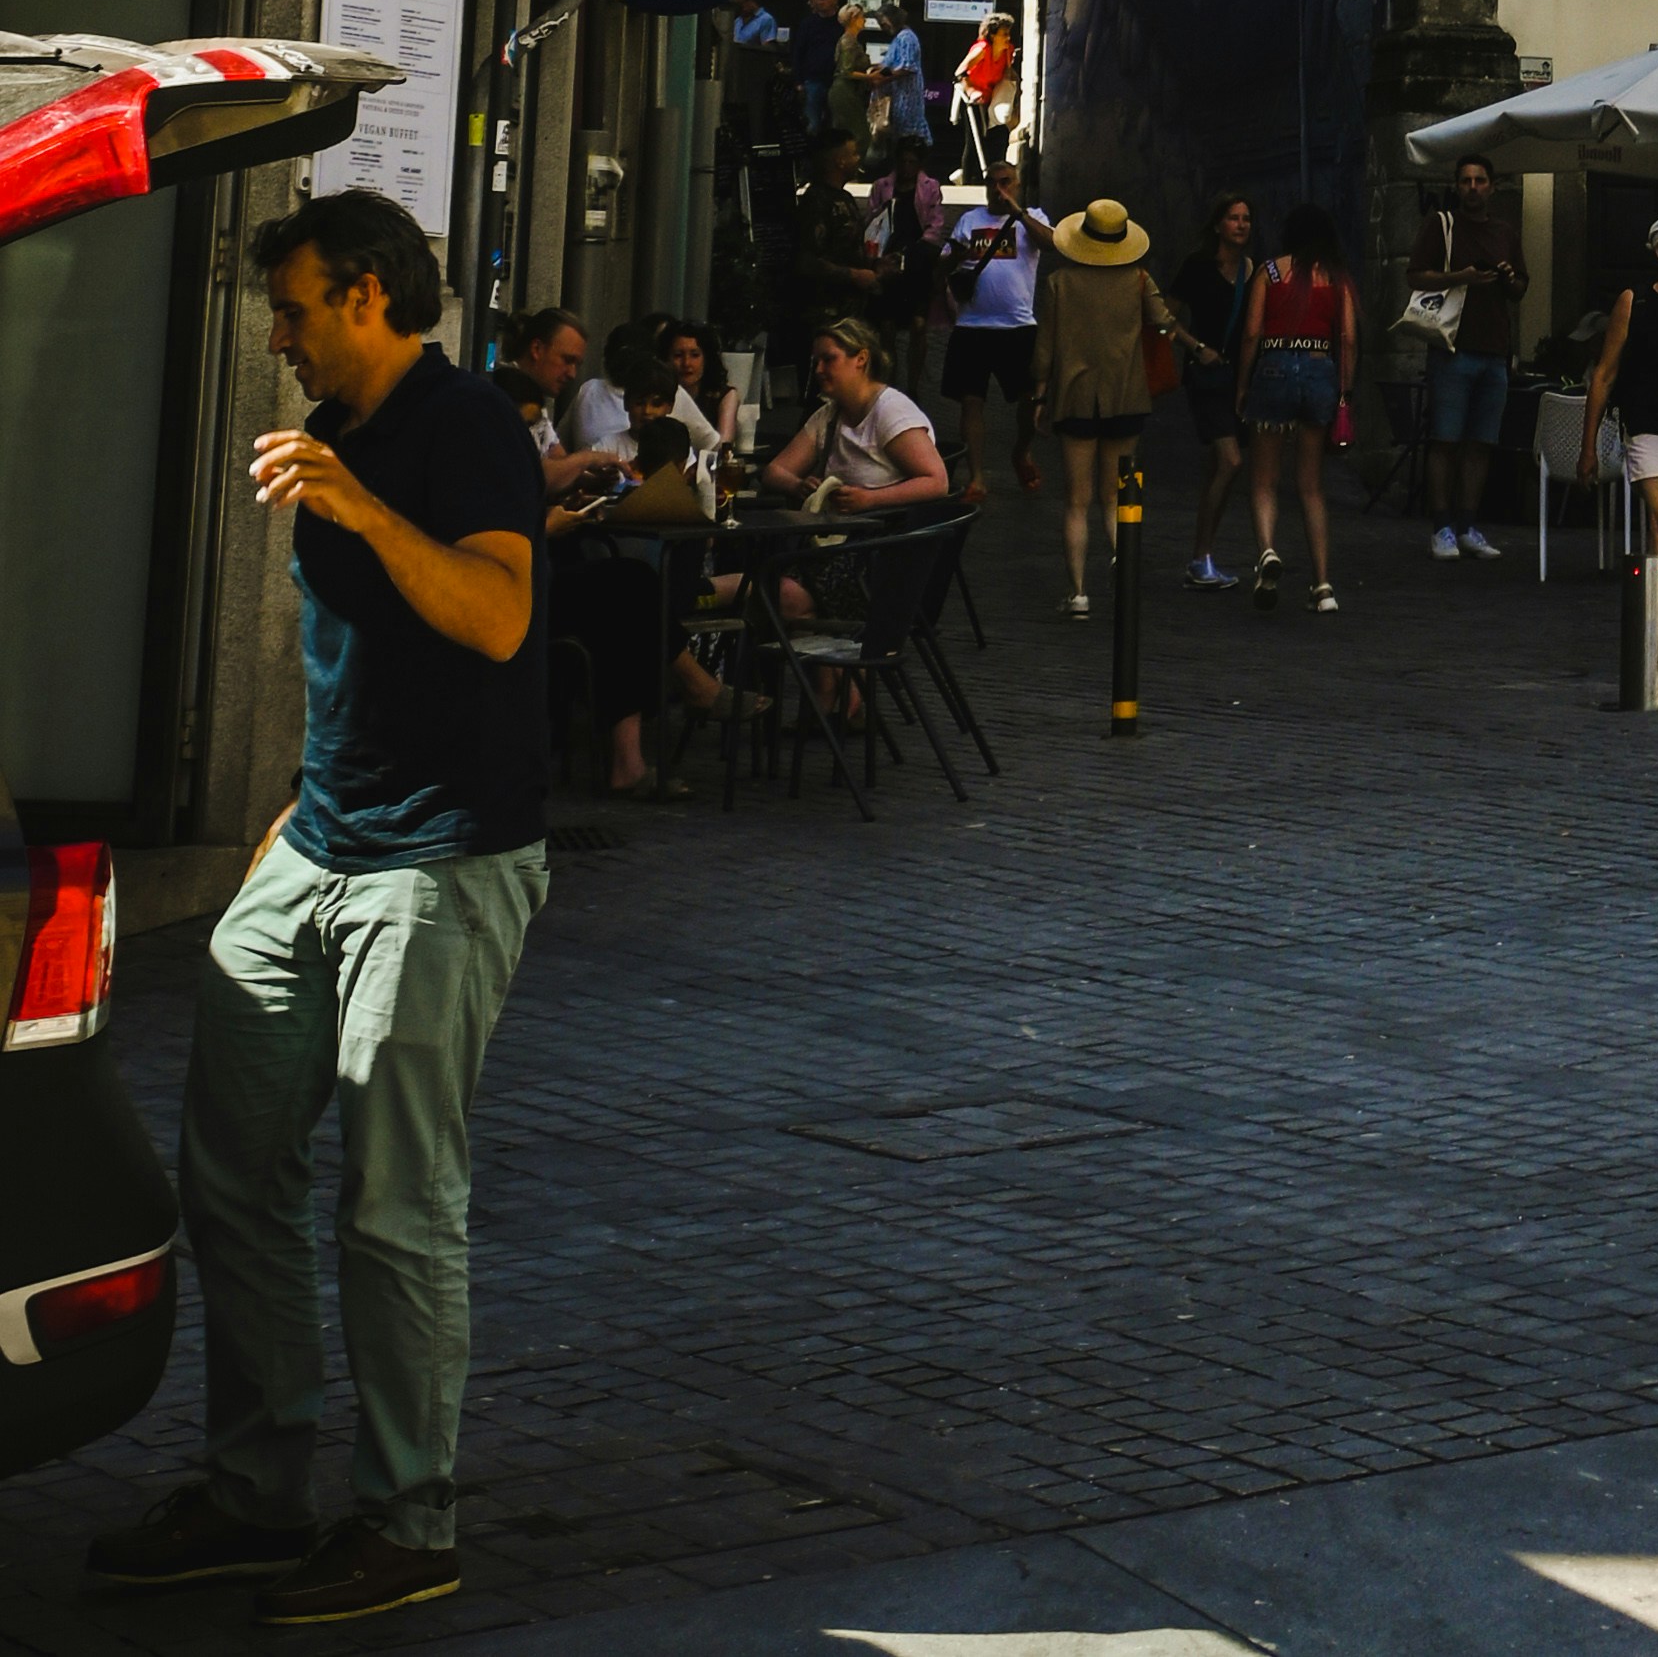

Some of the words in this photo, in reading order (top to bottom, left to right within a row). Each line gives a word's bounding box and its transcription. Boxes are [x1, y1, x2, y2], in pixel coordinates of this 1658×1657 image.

[359, 124, 387, 136] VEGAN
[389, 127, 419, 140] BUFFET
[975, 238, 1008, 247] HUO
